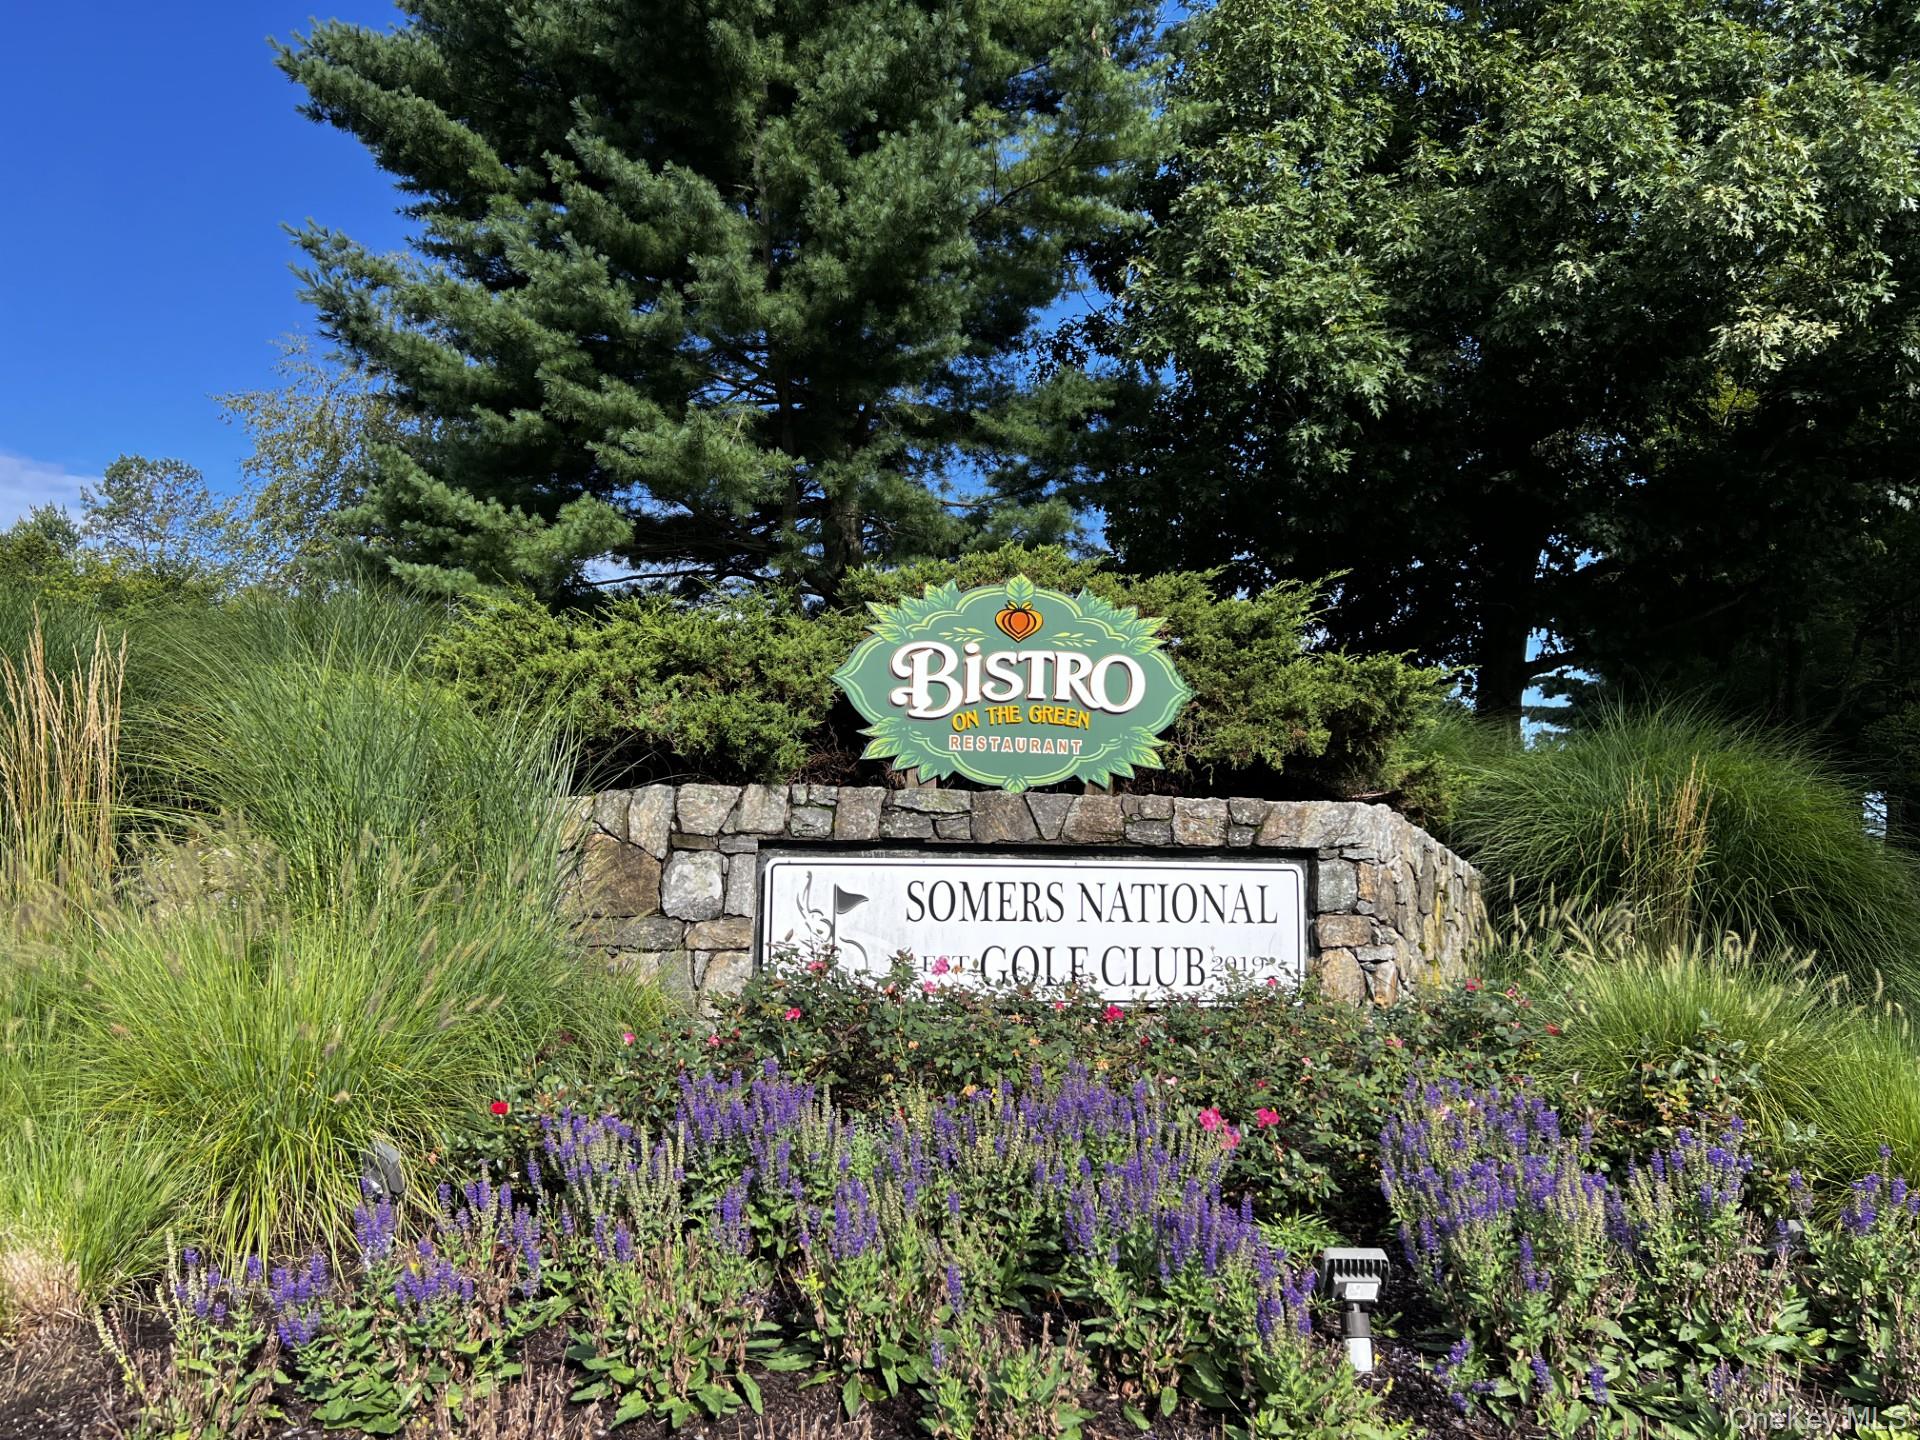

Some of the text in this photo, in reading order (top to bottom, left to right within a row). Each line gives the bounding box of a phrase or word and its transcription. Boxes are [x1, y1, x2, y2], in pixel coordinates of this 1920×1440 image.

[951, 704, 1091, 733] ON THE GREEN
[948, 734, 1083, 755] RESTAURANT
[905, 879, 1278, 925] SOMERS NATIONAL
[980, 945, 1089, 987] GOLF
[1101, 945, 1206, 988] CLUB
[1211, 955, 1264, 975] 2019
